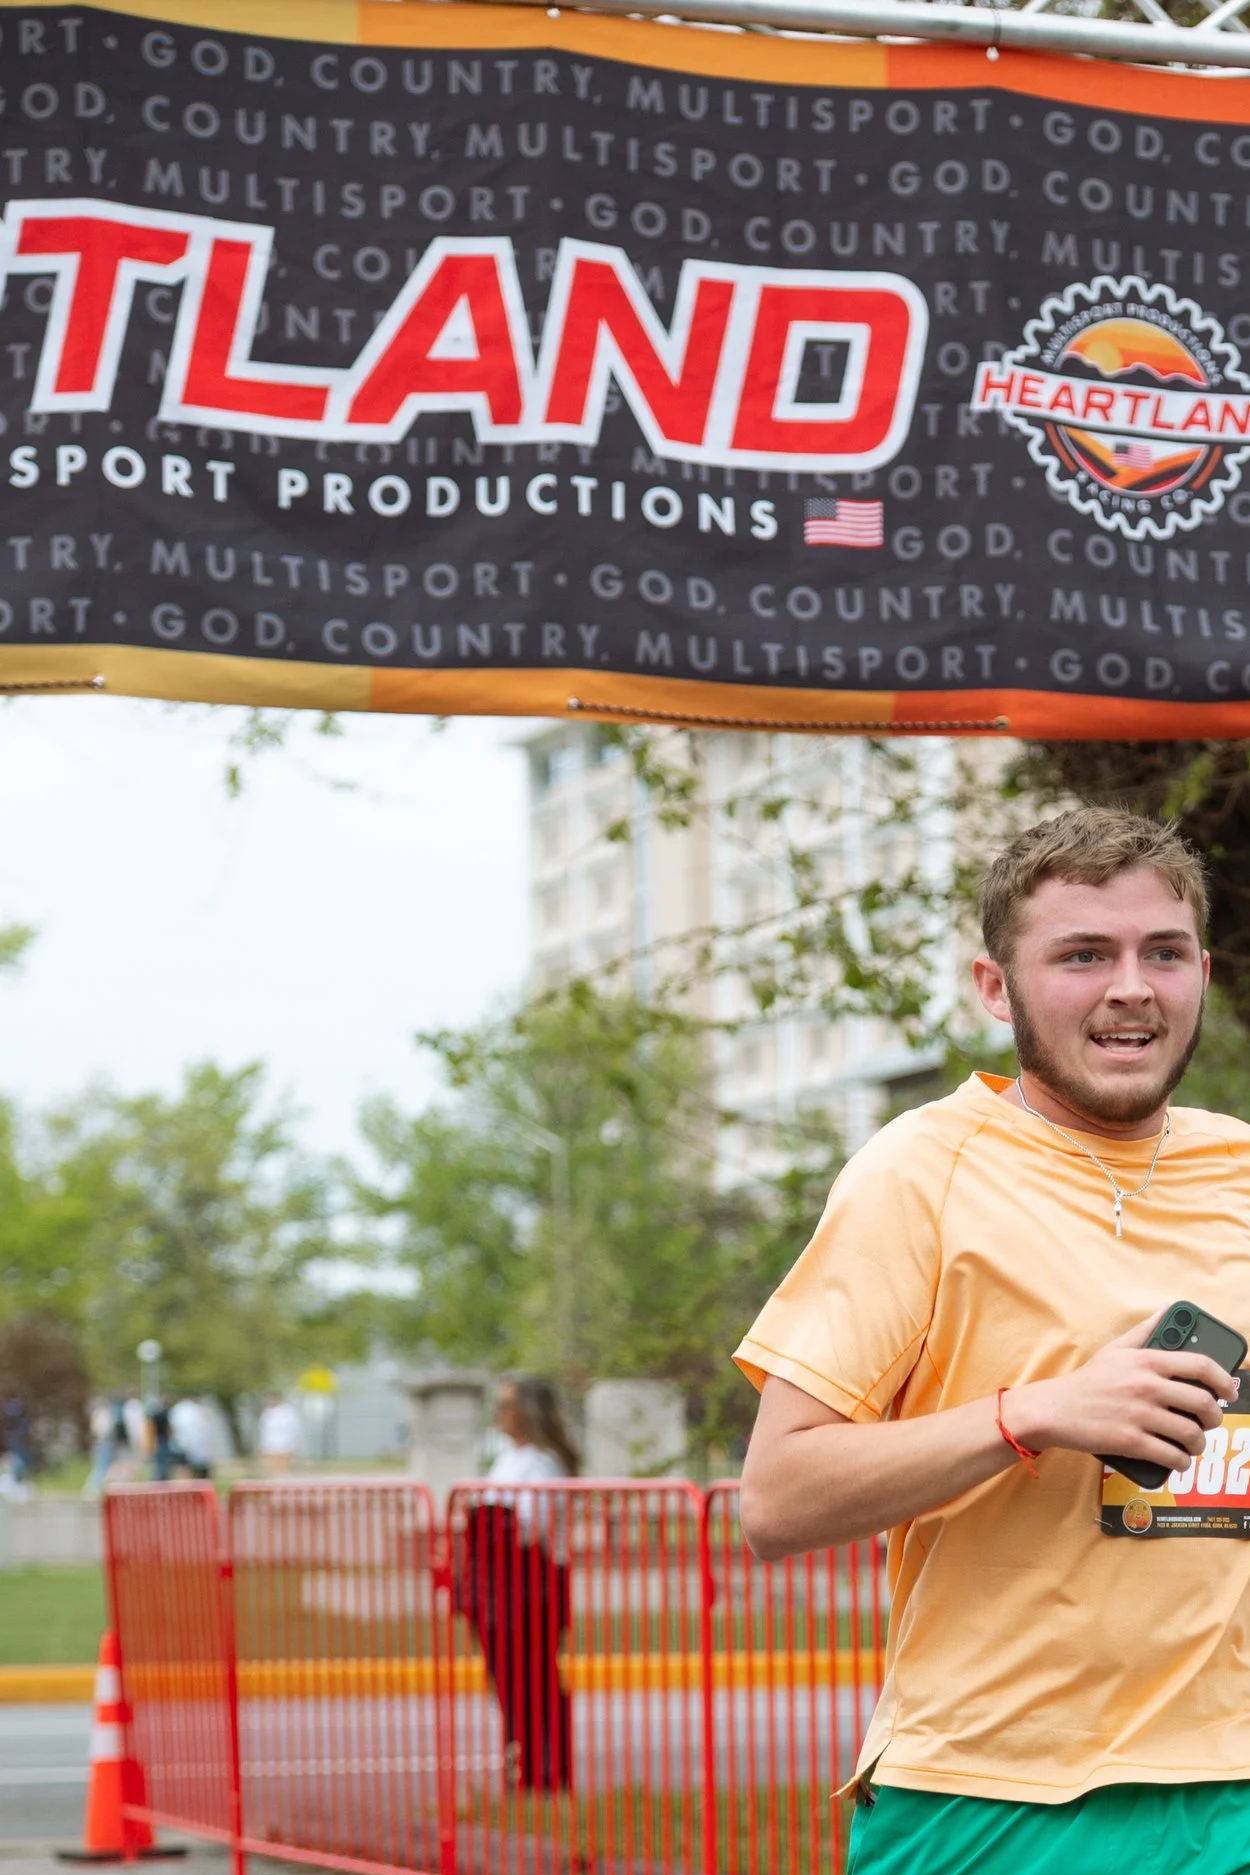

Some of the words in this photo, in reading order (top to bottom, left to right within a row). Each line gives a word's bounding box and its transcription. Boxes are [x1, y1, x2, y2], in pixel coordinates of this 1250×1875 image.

[0, 18, 83, 55] RT
[141, 31, 285, 87] GOD,
[310, 54, 602, 105] COUNTRY,
[626, 76, 993, 136] MULTISPORT
[1042, 111, 1171, 164] GOD,
[0, 81, 116, 125] OD,
[141, 94, 440, 161] COUNTRY,
[464, 121, 838, 195] MULTISPORT
[887, 158, 1019, 198] GOD,
[143, 157, 531, 222] MULTISPORT
[584, 192, 721, 251] GOD,
[744, 215, 1018, 259] COUNTRY,
[1126, 301, 1224, 386] PRODUCTIONS
[8, 444, 236, 502] SPORT
[277, 468, 779, 541] PRODUCTIONS
[1075, 470, 1151, 515] RACING
[149, 538, 536, 600] MULTISPORT
[589, 563, 726, 615] GOD,
[748, 583, 1025, 623] COUNTRY,
[891, 522, 1023, 561] GOD,
[149, 602, 297, 652] GOD,
[321, 617, 610, 662] COUNTRY,
[636, 629, 998, 680] MULTISPORT
